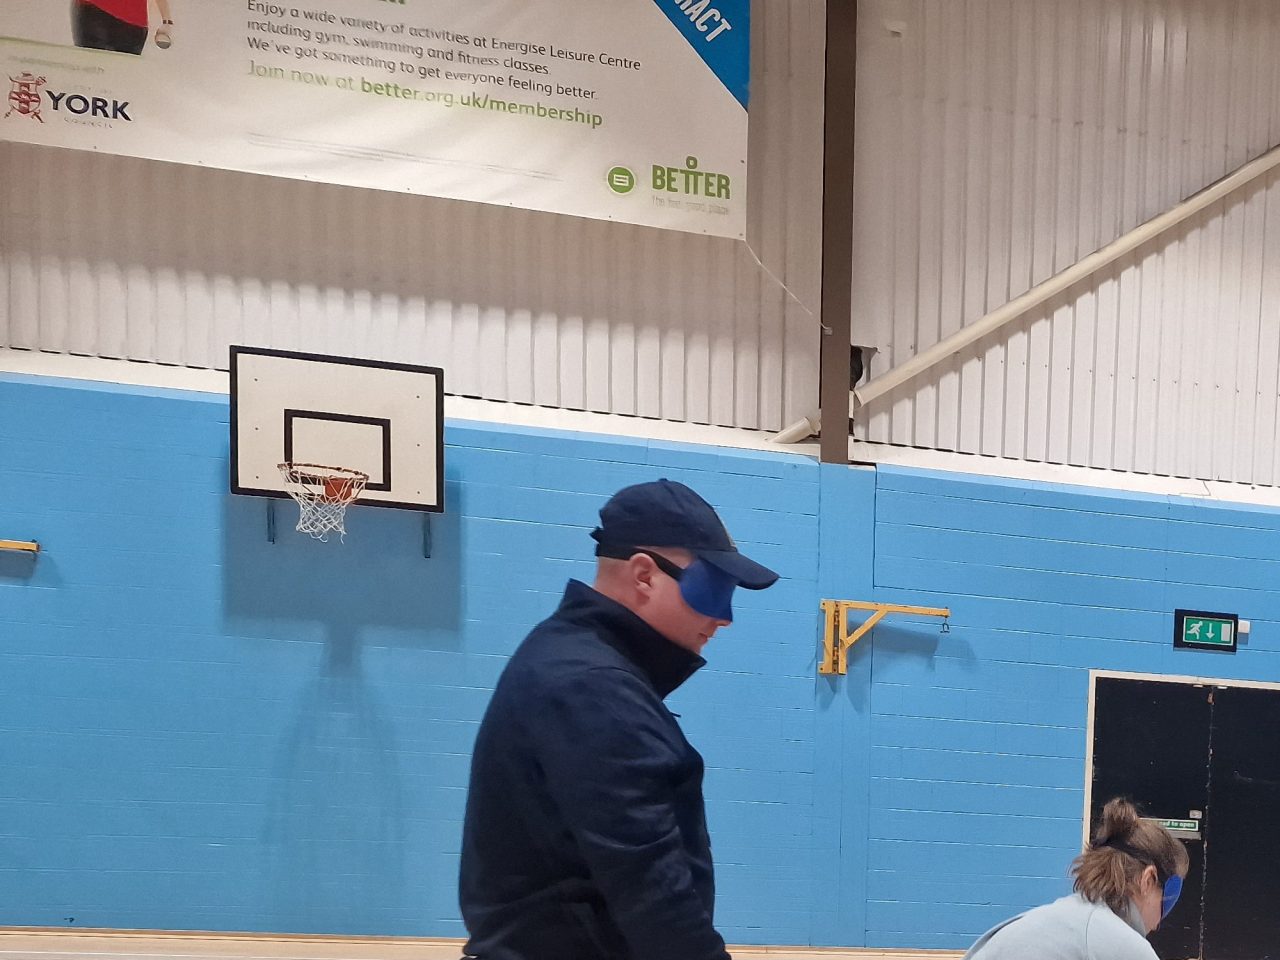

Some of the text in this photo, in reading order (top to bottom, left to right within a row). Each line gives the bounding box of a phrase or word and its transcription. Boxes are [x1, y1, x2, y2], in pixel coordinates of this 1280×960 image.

[247, 0, 641, 71] Enjoy a wide variety of activities at Energise Leisure Centre
[247, 21, 311, 41] including
[353, 37, 424, 59] swimming
[427, 48, 454, 62] and
[458, 51, 500, 66] fitness
[247, 37, 291, 55] We've
[295, 47, 319, 60] got
[322, 50, 396, 74] something
[400, 61, 415, 74] to
[418, 66, 441, 80] get
[444, 70, 505, 86] everyone
[508, 75, 552, 97] feeling
[45, 89, 133, 122] YORK
[248, 60, 603, 129] Join now at better.org.uk/membership
[652, 163, 731, 200] BETTER
